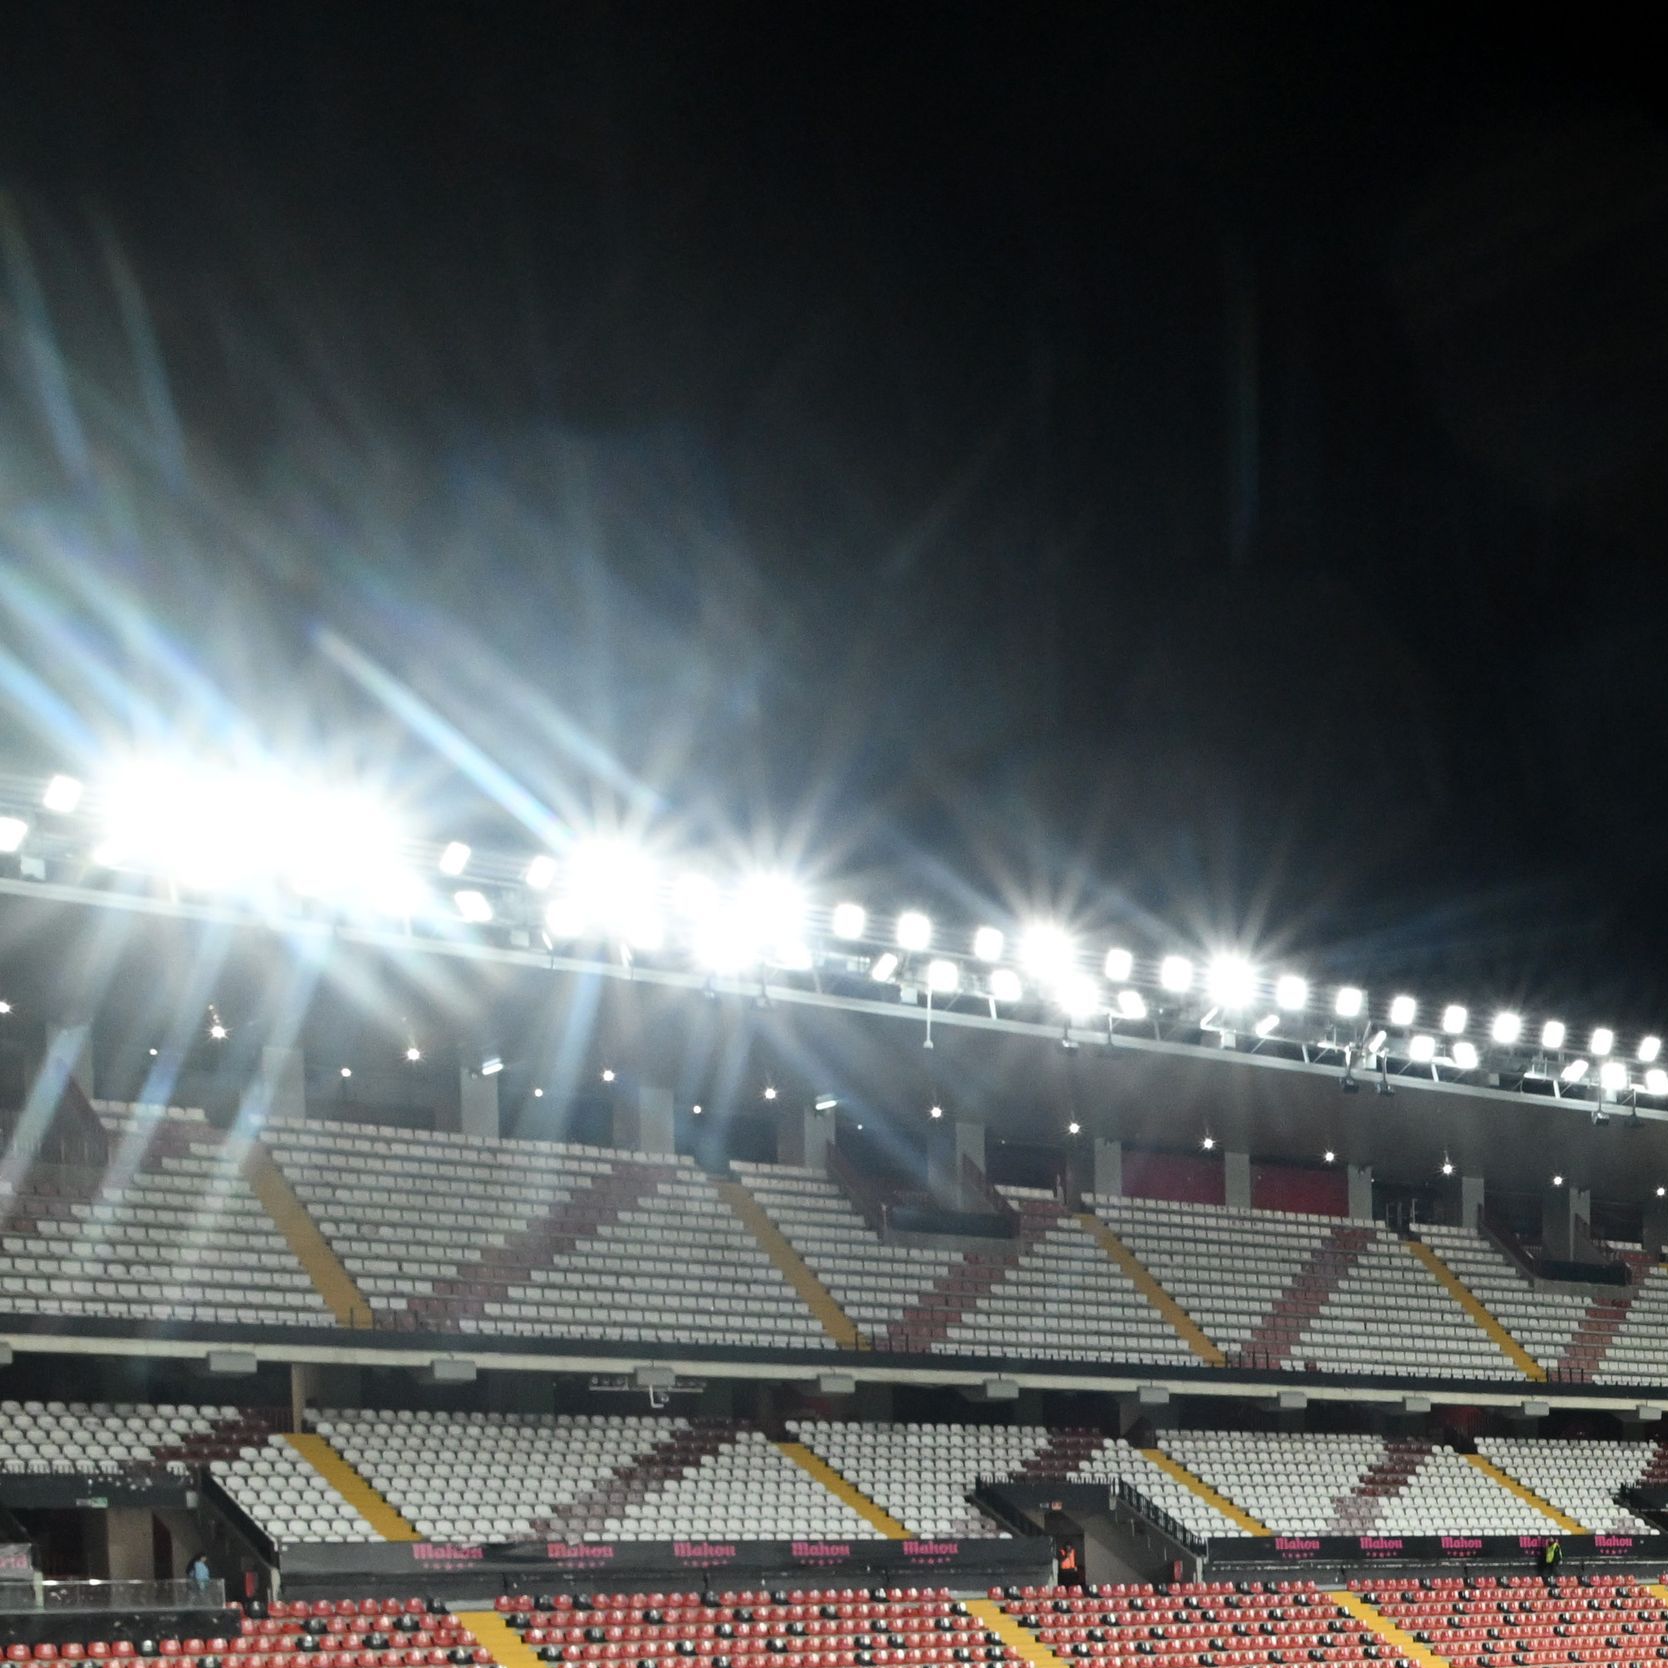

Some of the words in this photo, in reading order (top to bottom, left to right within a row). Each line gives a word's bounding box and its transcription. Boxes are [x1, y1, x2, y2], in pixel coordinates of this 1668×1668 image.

[902, 1541, 959, 1555] Mahou
[1275, 1537, 1320, 1550] Mahou
[1359, 1536, 1403, 1549] Mahou
[1441, 1536, 1483, 1548] Mahou
[1594, 1535, 1633, 1548] Mahou
